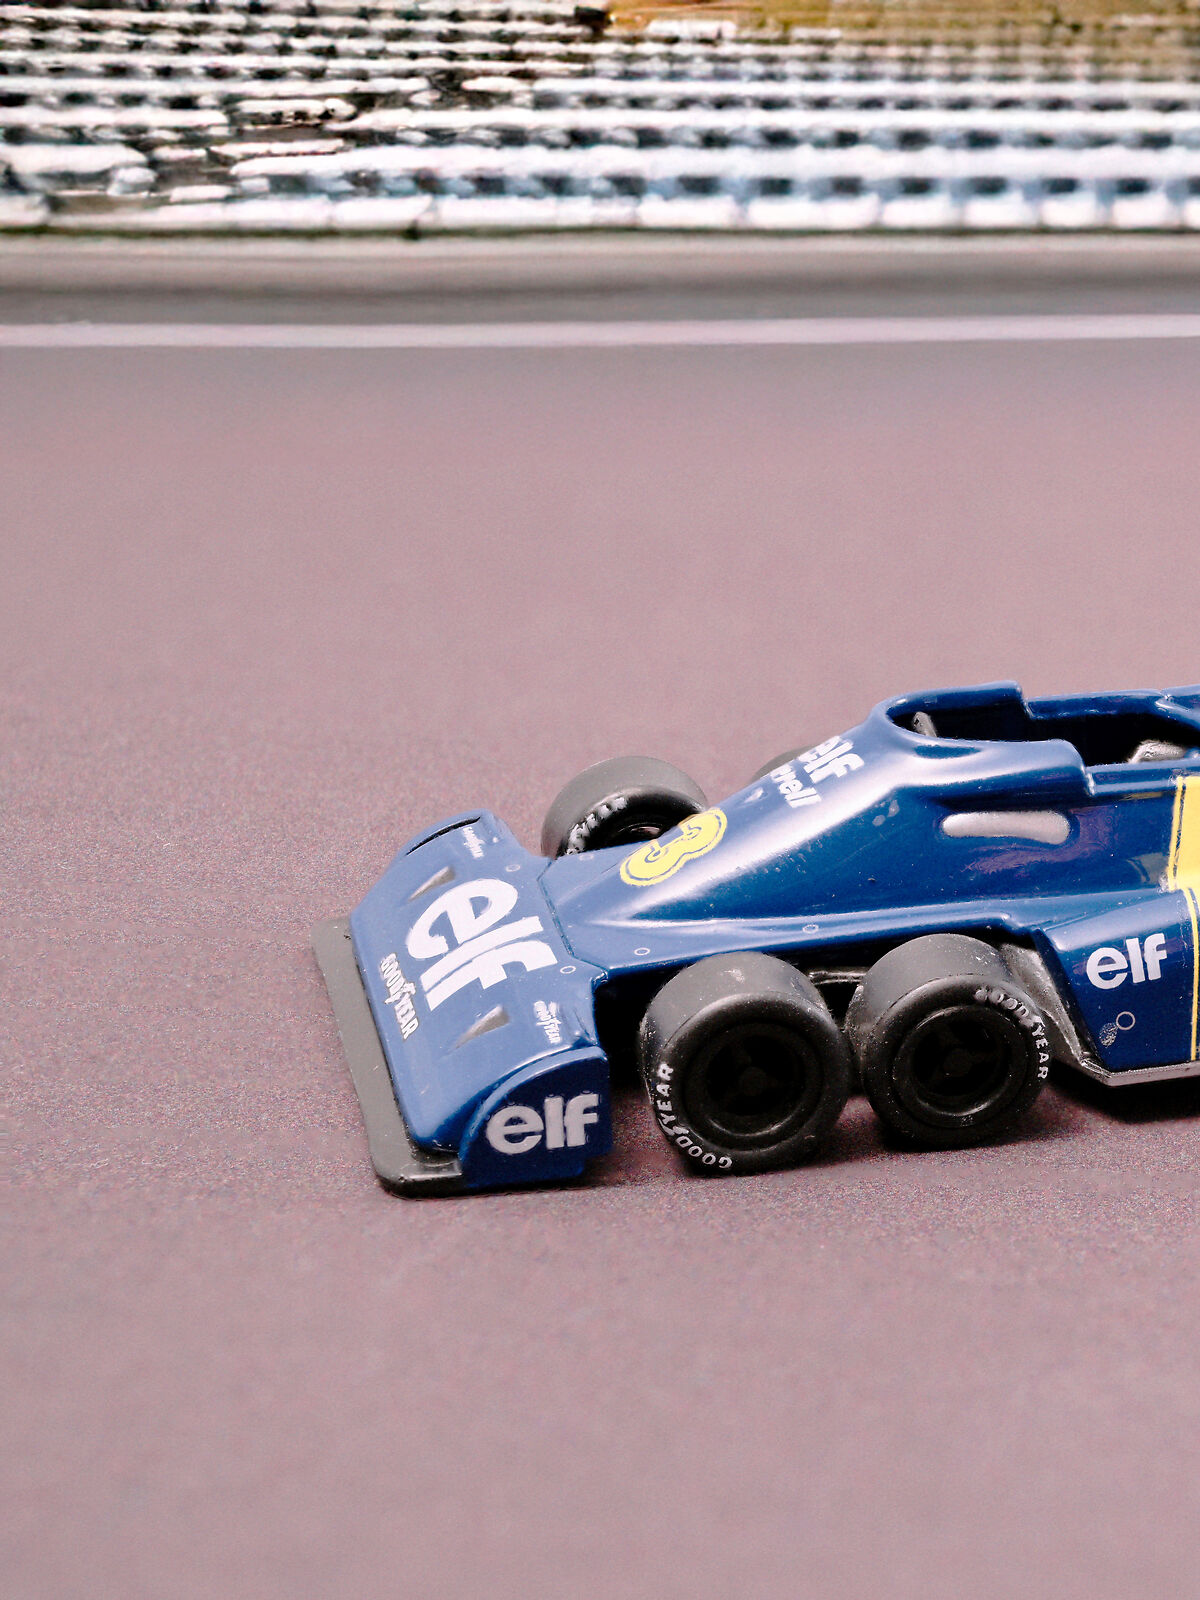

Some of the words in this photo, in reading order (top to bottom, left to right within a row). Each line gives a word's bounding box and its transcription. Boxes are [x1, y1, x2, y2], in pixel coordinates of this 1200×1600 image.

[619, 807, 728, 887] 3
[405, 878, 558, 1012] elf
[1086, 933, 1168, 990] elf
[486, 1092, 600, 1156] elf
